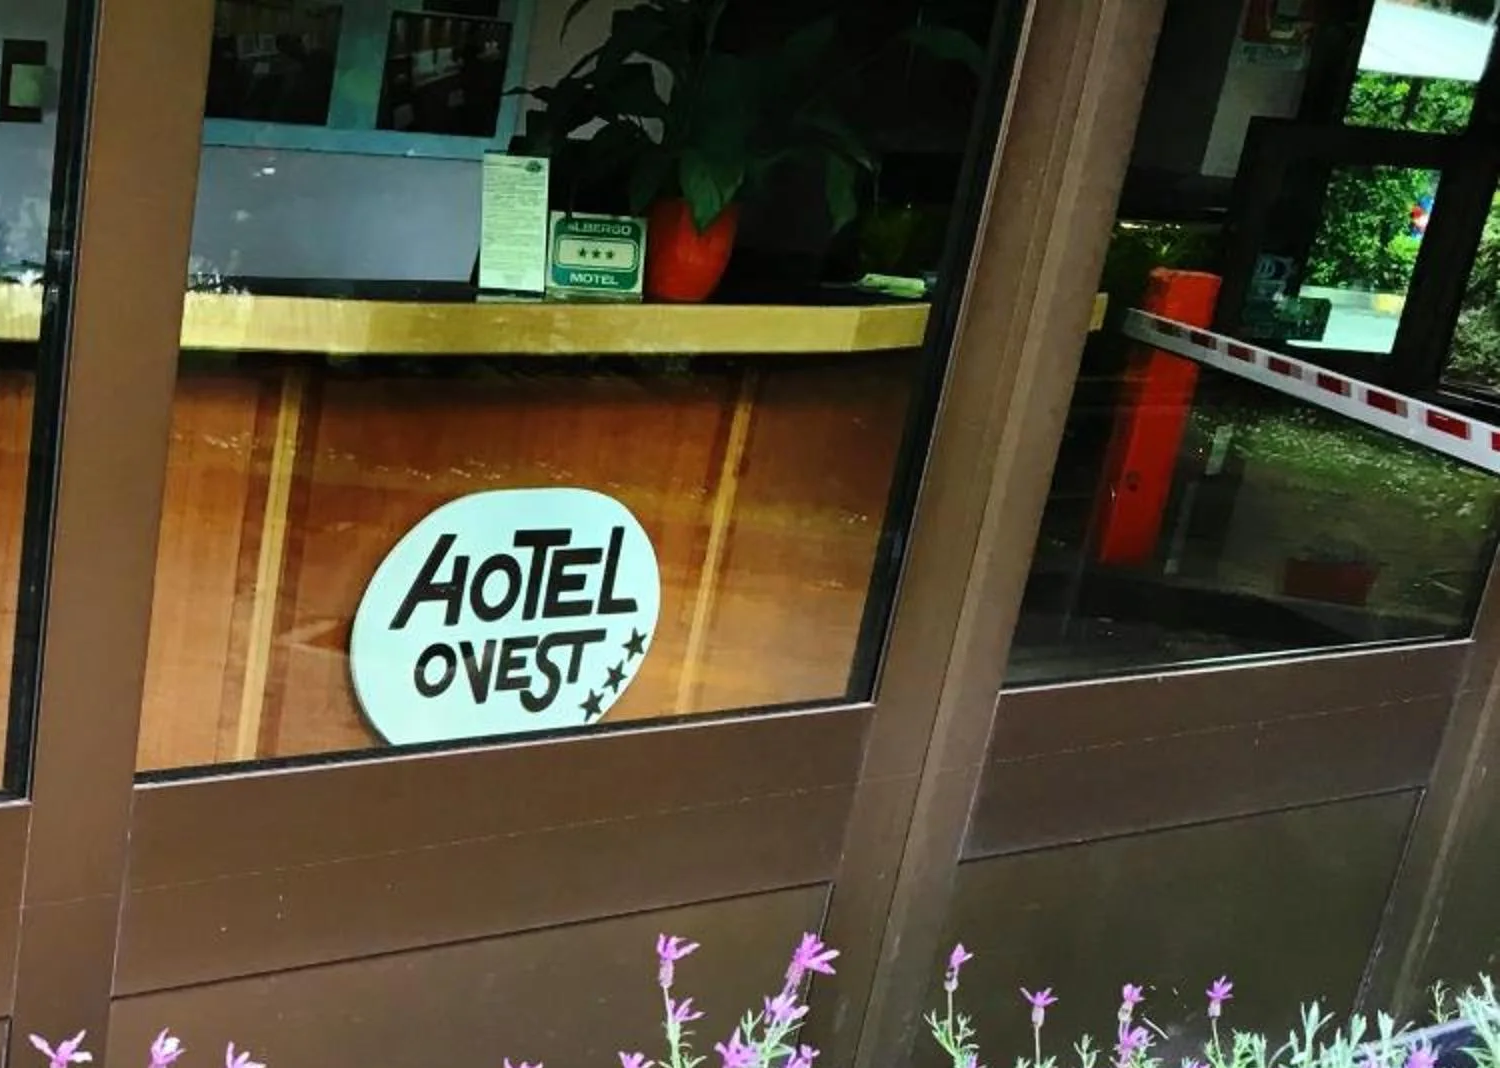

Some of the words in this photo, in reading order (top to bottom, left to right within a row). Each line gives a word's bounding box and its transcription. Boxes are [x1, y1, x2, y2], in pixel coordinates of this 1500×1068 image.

[569, 271, 619, 286] MOTEL
[388, 526, 639, 630] HOTEL
[414, 628, 607, 712] OVEST
